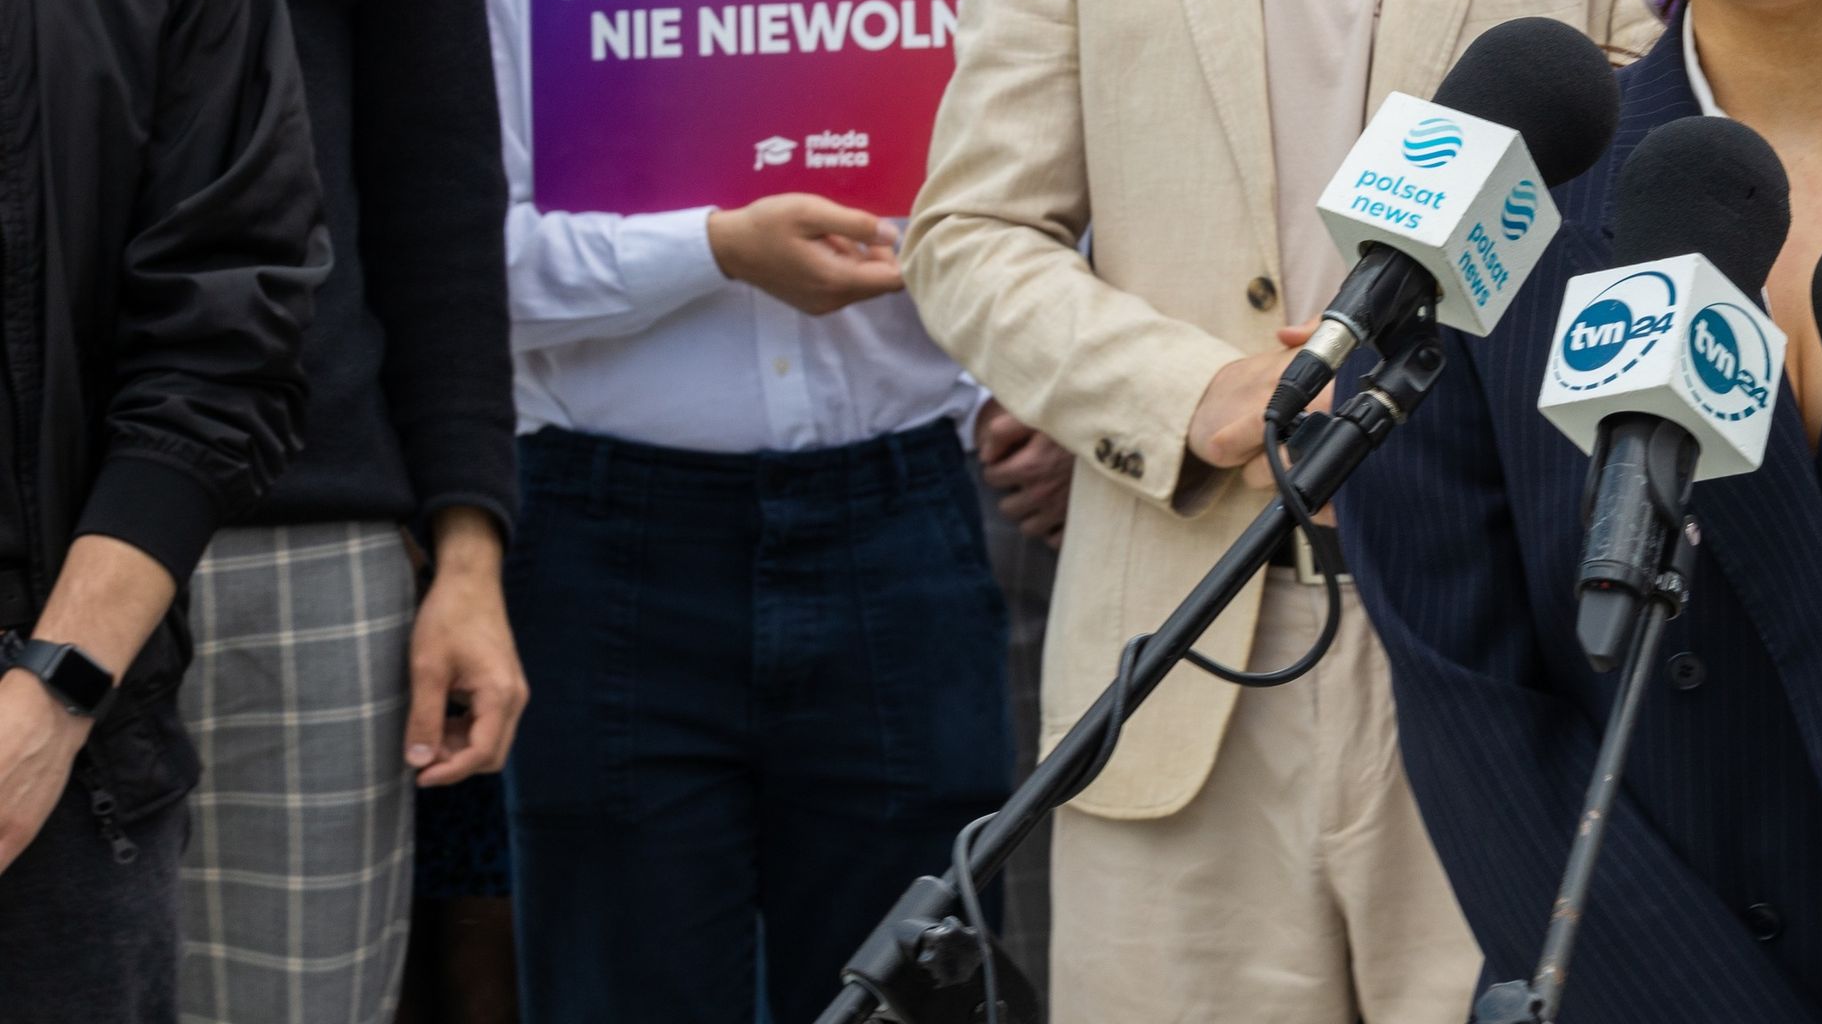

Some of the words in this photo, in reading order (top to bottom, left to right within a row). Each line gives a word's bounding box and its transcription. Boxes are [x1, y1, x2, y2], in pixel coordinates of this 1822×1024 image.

[590, 7, 682, 61] NIE
[1350, 194, 1423, 229] news
[1354, 169, 1447, 210] polsat
[1457, 250, 1491, 307] news
[1466, 222, 1510, 291] polsat
